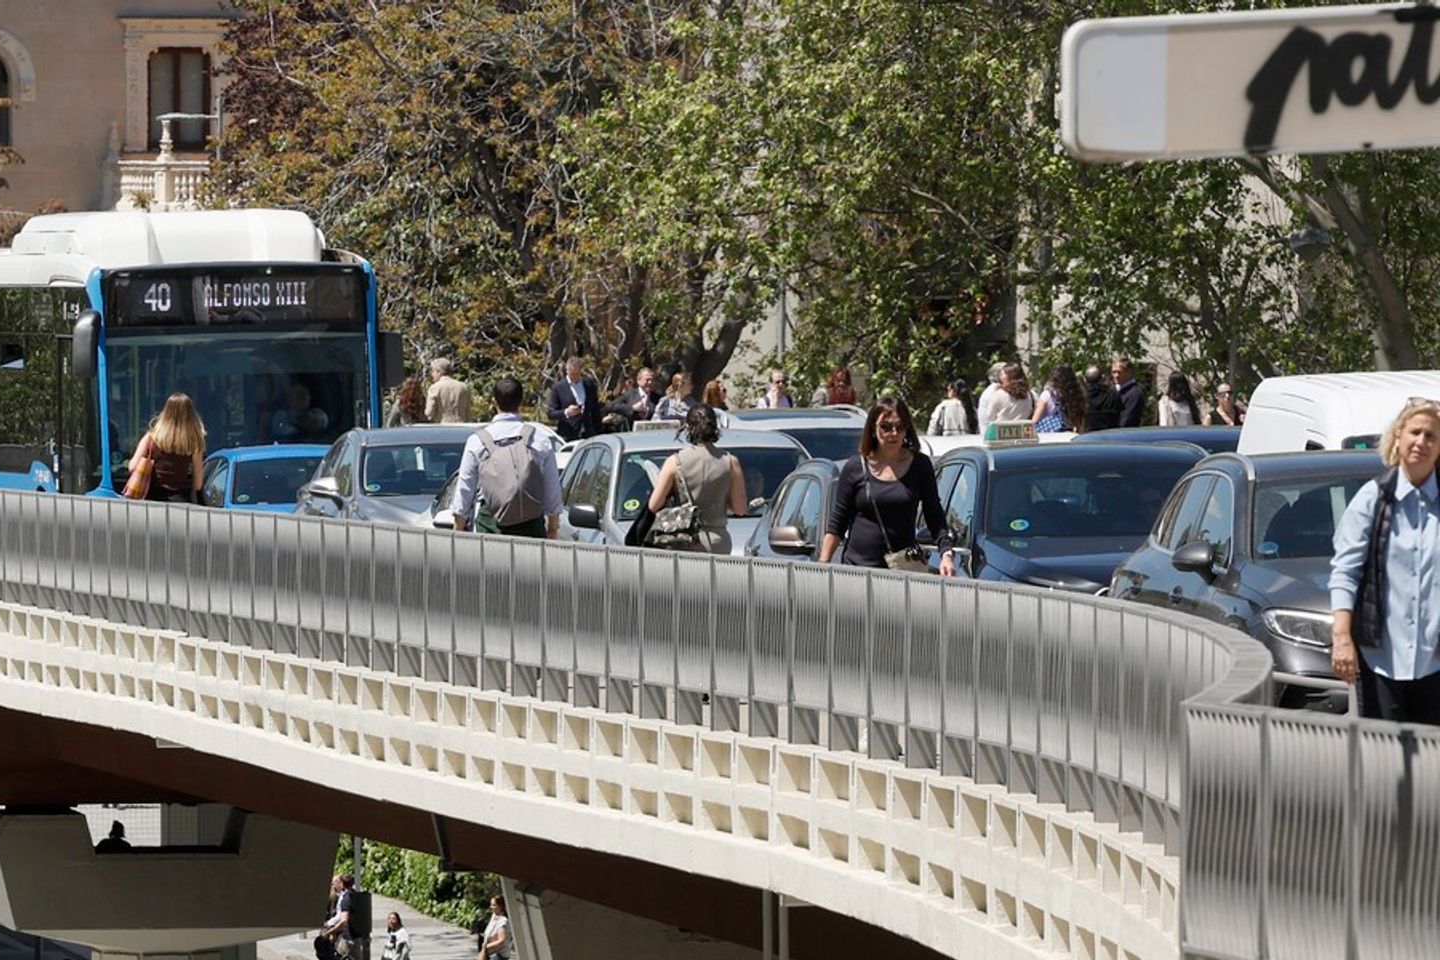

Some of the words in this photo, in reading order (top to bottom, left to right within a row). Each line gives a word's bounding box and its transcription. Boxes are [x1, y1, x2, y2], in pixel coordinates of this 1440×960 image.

[144, 283, 172, 312] 40
[204, 283, 270, 307] ALFONSO
[276, 281, 307, 305] XIII
